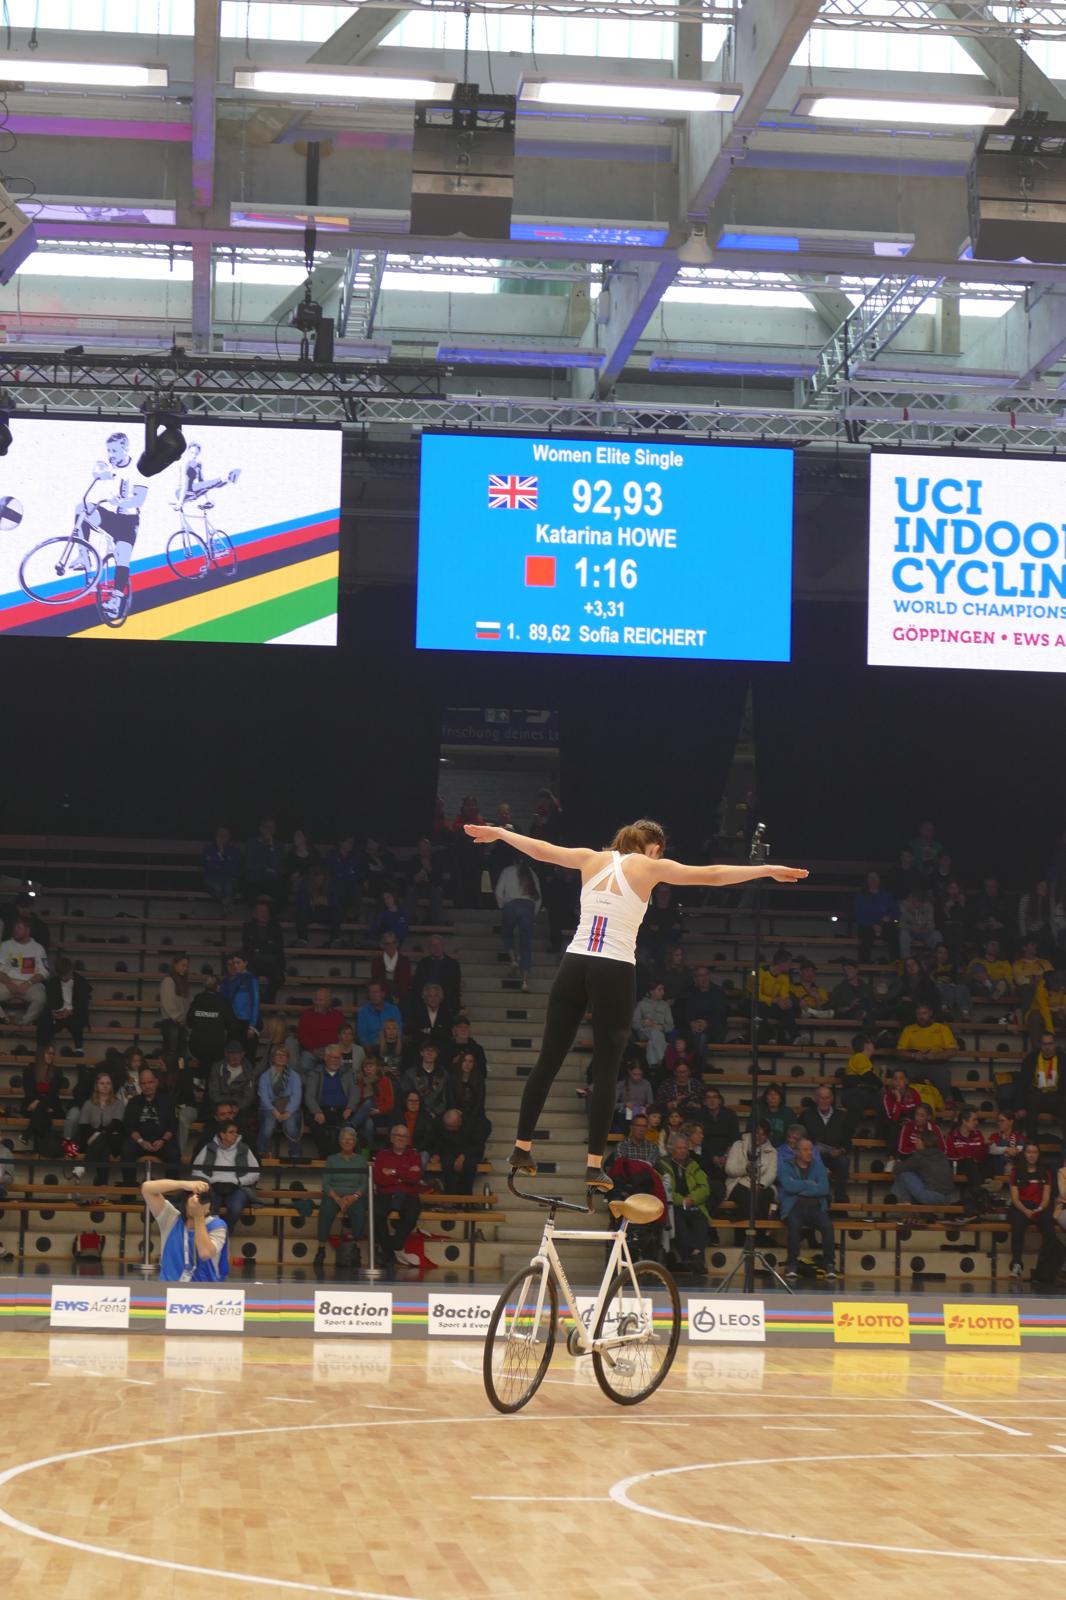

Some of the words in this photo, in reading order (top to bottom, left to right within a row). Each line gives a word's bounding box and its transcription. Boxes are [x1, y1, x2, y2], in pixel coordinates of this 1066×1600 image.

[533, 444, 592, 464] Women
[596, 446, 631, 465] Elite
[634, 448, 684, 470] Single
[572, 479, 664, 520] 92,93
[894, 476, 983, 516] UCI
[536, 523, 613, 547] Katarina
[617, 527, 677, 549] HOWE
[574, 557, 638, 589] 1:16
[583, 600, 625, 618] +3,31
[893, 599, 958, 615] WORLD
[506, 623, 521, 640] 1.
[528, 624, 571, 643] 89,62
[579, 626, 620, 644] Sofia
[623, 628, 707, 647] REICHERT
[893, 624, 996, 645] GÖPPINGEN
[1013, 632, 1050, 647] EWS
[54, 1300, 89, 1311] EWS
[90, 1301, 127, 1313] Arena
[169, 1303, 204, 1315] EWS
[205, 1304, 242, 1316] Arena
[318, 1301, 389, 1317] 8action
[432, 1304, 494, 1319] 8actio
[324, 1319, 345, 1327] Sport
[719, 1314, 761, 1326] LEOS
[857, 1314, 904, 1328] LOTTO
[967, 1316, 1015, 1329] LOTTO
